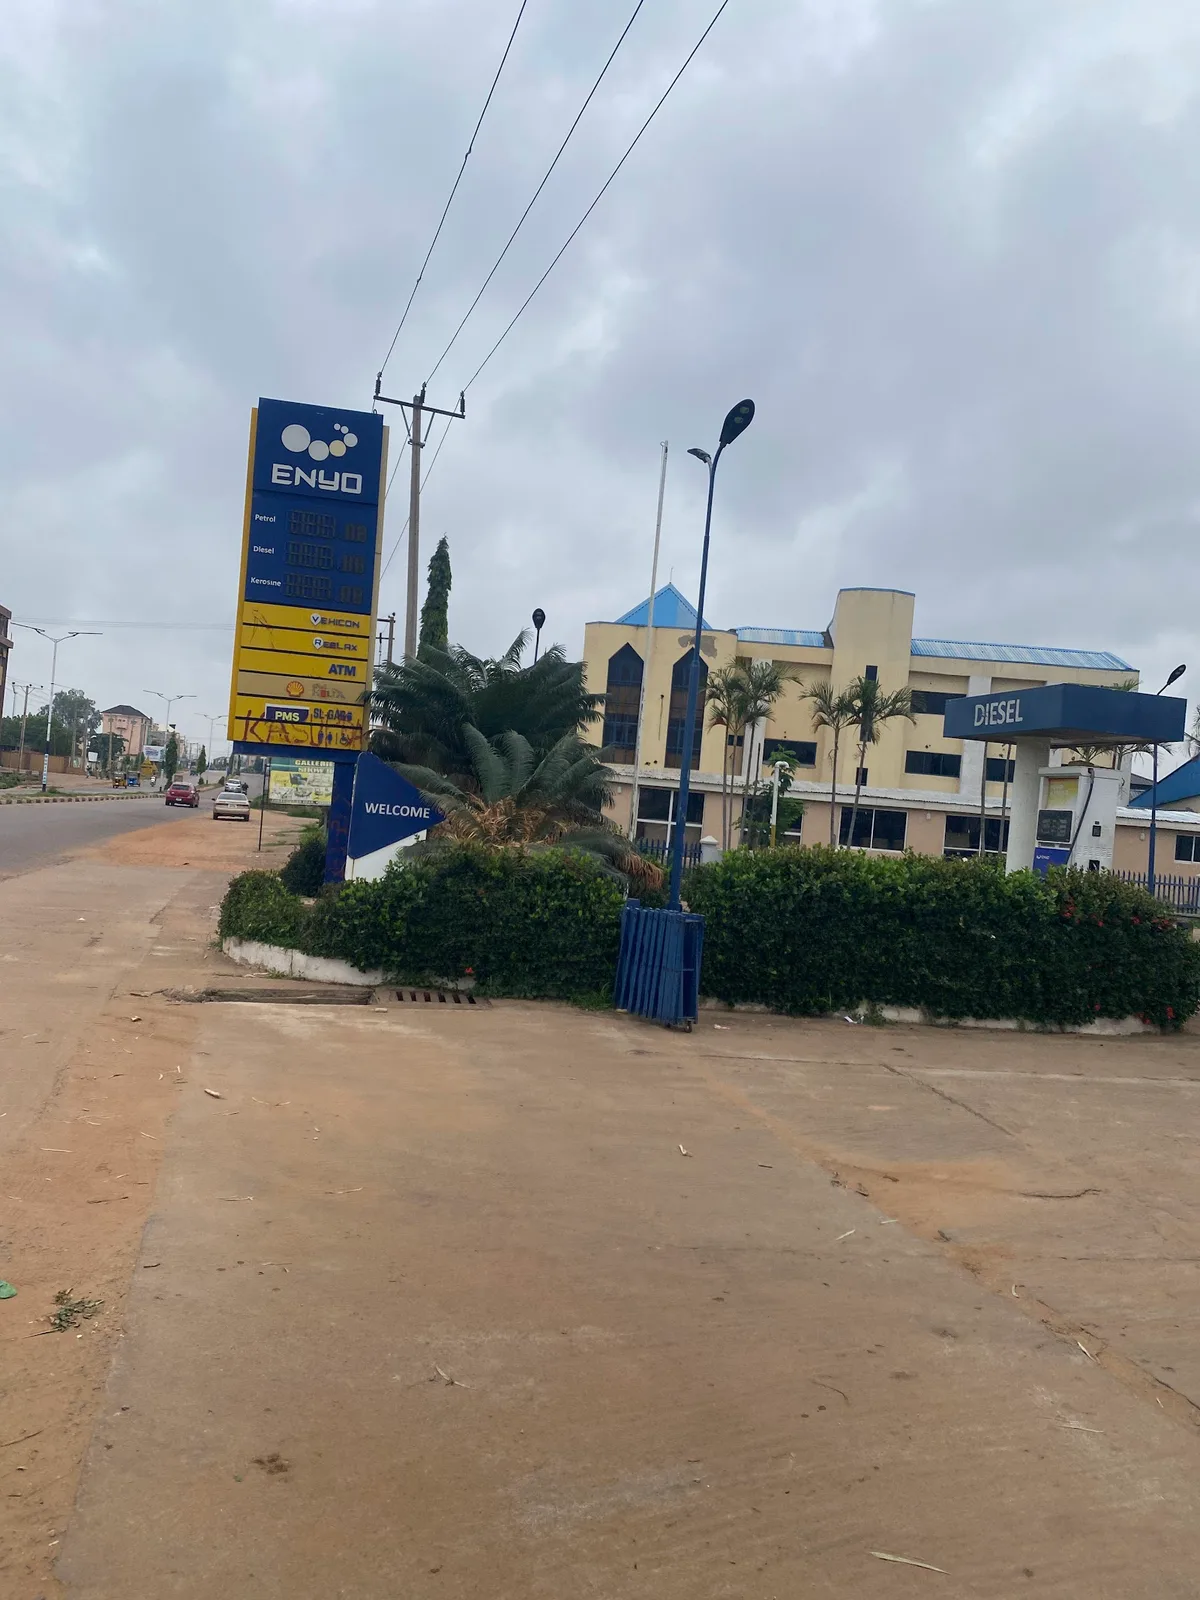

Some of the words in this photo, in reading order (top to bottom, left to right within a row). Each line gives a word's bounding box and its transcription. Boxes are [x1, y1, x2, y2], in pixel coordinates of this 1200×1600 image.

[271, 463, 362, 494] ENYO
[255, 514, 276, 523] Petrol
[253, 545, 275, 554] Diesel
[250, 577, 282, 587] Kerosine
[311, 615, 360, 629] VEHICON
[328, 664, 356, 677] ATM
[275, 711, 300, 722] PMS
[974, 699, 1023, 727] DIESEL
[365, 802, 430, 819] WELCOME
